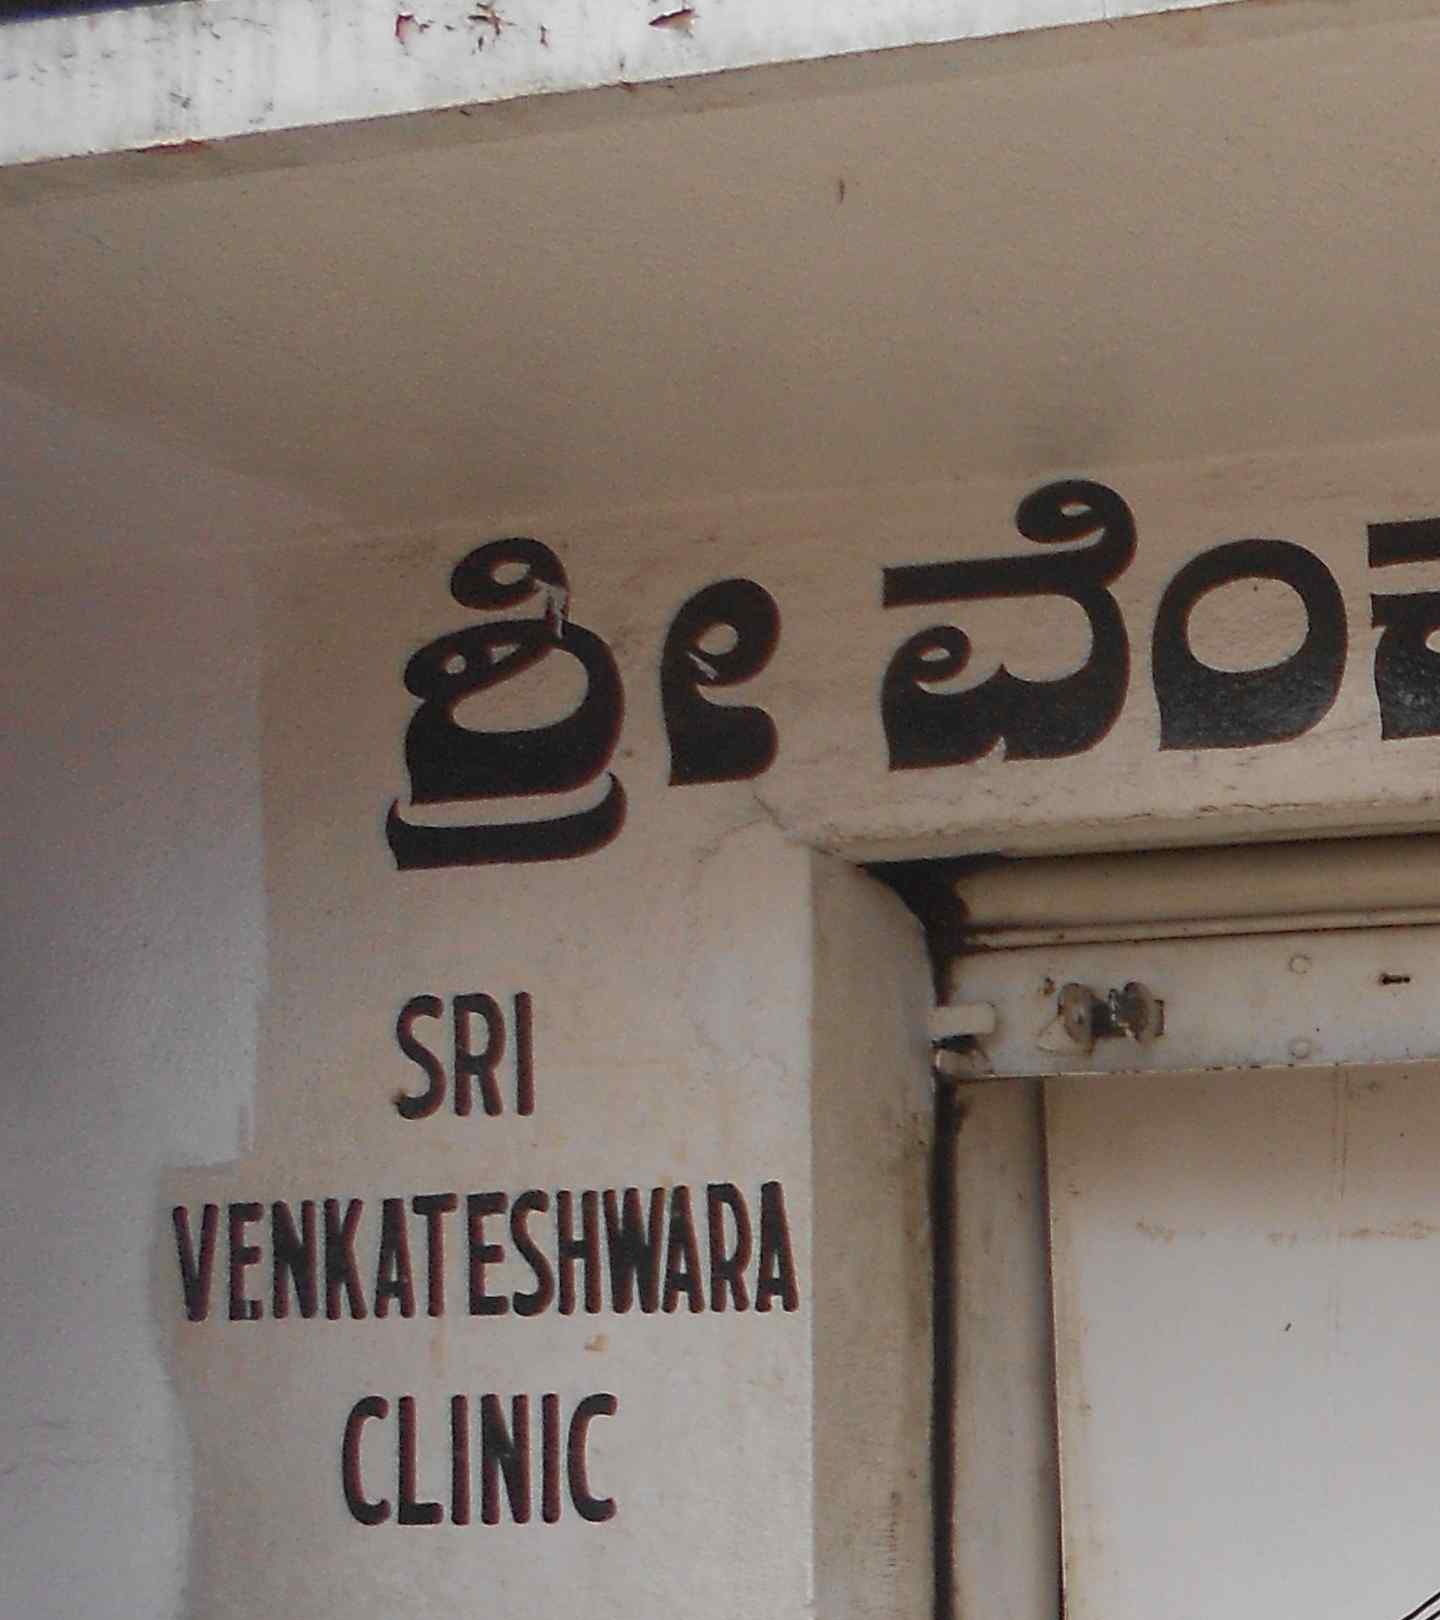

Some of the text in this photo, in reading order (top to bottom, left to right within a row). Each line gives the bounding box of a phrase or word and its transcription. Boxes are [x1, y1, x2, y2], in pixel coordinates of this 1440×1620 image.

[384, 536, 781, 871] ಶ್ರೀ
[392, 991, 534, 1120] SRI
[170, 1181, 798, 1323] VENKATESHWARA
[340, 1393, 617, 1526] CLINIC
